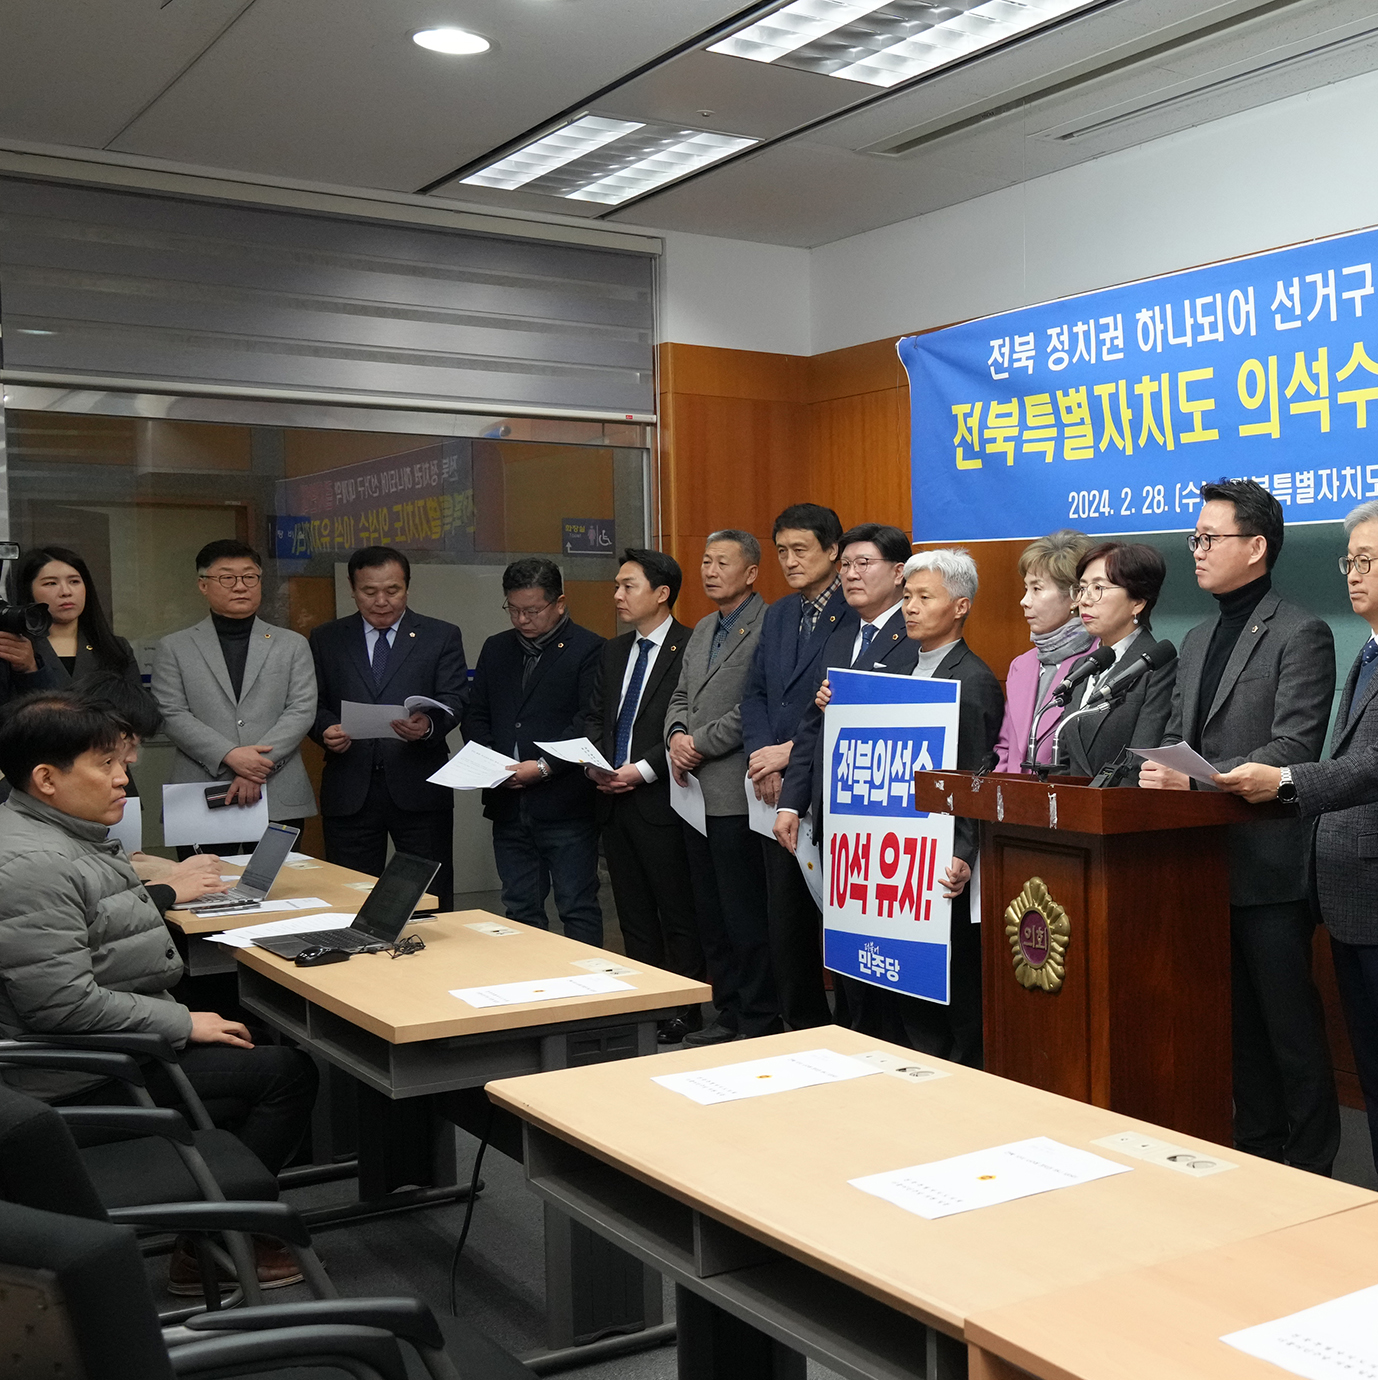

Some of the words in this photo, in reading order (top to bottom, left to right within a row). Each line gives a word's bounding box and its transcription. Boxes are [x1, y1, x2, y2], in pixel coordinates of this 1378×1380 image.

[987, 331, 1037, 381] 전북
[1045, 313, 1125, 373] 정치권
[1135, 286, 1257, 353] 하나되어
[1269, 261, 1375, 333] 선거구
[950, 366, 1219, 471] 전북특별자치도
[1068, 488, 1114, 520] 2024.
[1120, 486, 1138, 516] 2.
[1142, 484, 1169, 514] 28.
[829, 831, 872, 916] 10석
[875, 831, 938, 922] 유지!
[858, 949, 901, 982] 민주당
[1023, 924, 1048, 951] 의회
